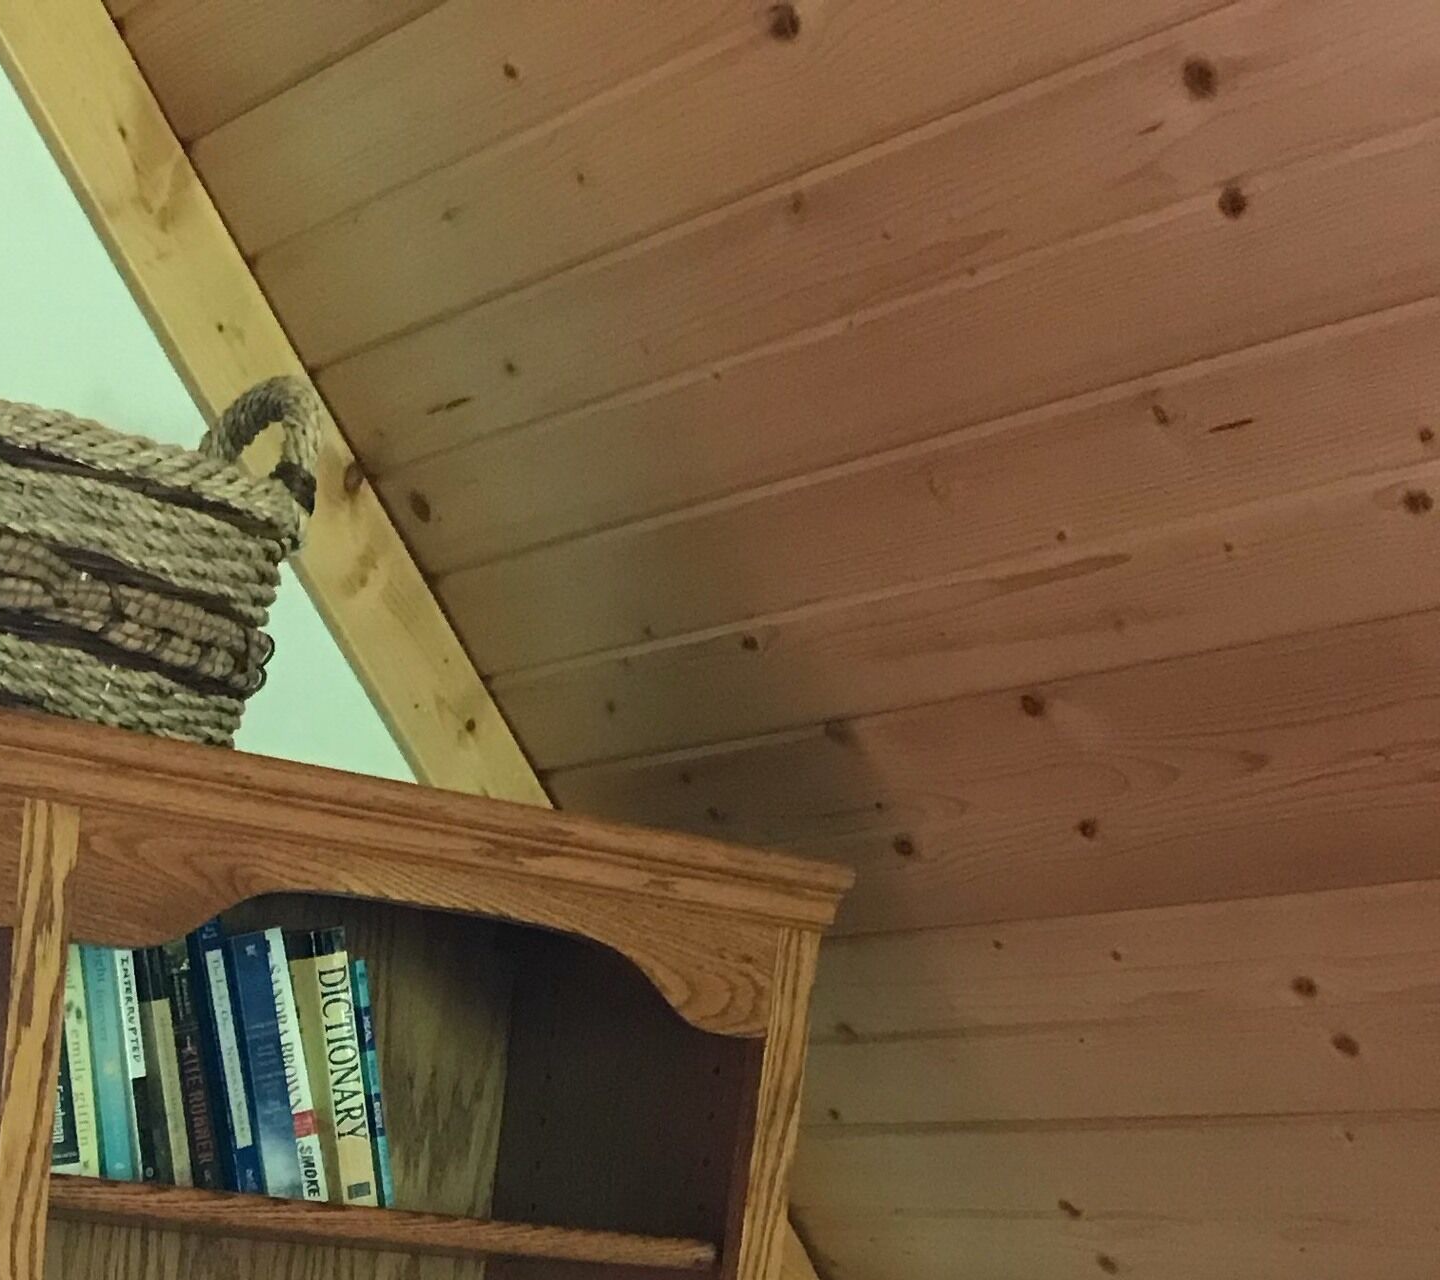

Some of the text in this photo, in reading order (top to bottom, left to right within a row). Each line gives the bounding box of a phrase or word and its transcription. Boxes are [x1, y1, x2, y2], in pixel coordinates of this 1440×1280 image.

[120, 955, 142, 1063] INTERRUPTED
[68, 1028, 86, 1084] emily
[280, 1041, 302, 1111] BROWN
[317, 965, 368, 1142] DICTIONARY
[297, 1143, 321, 1198] SMOKE
